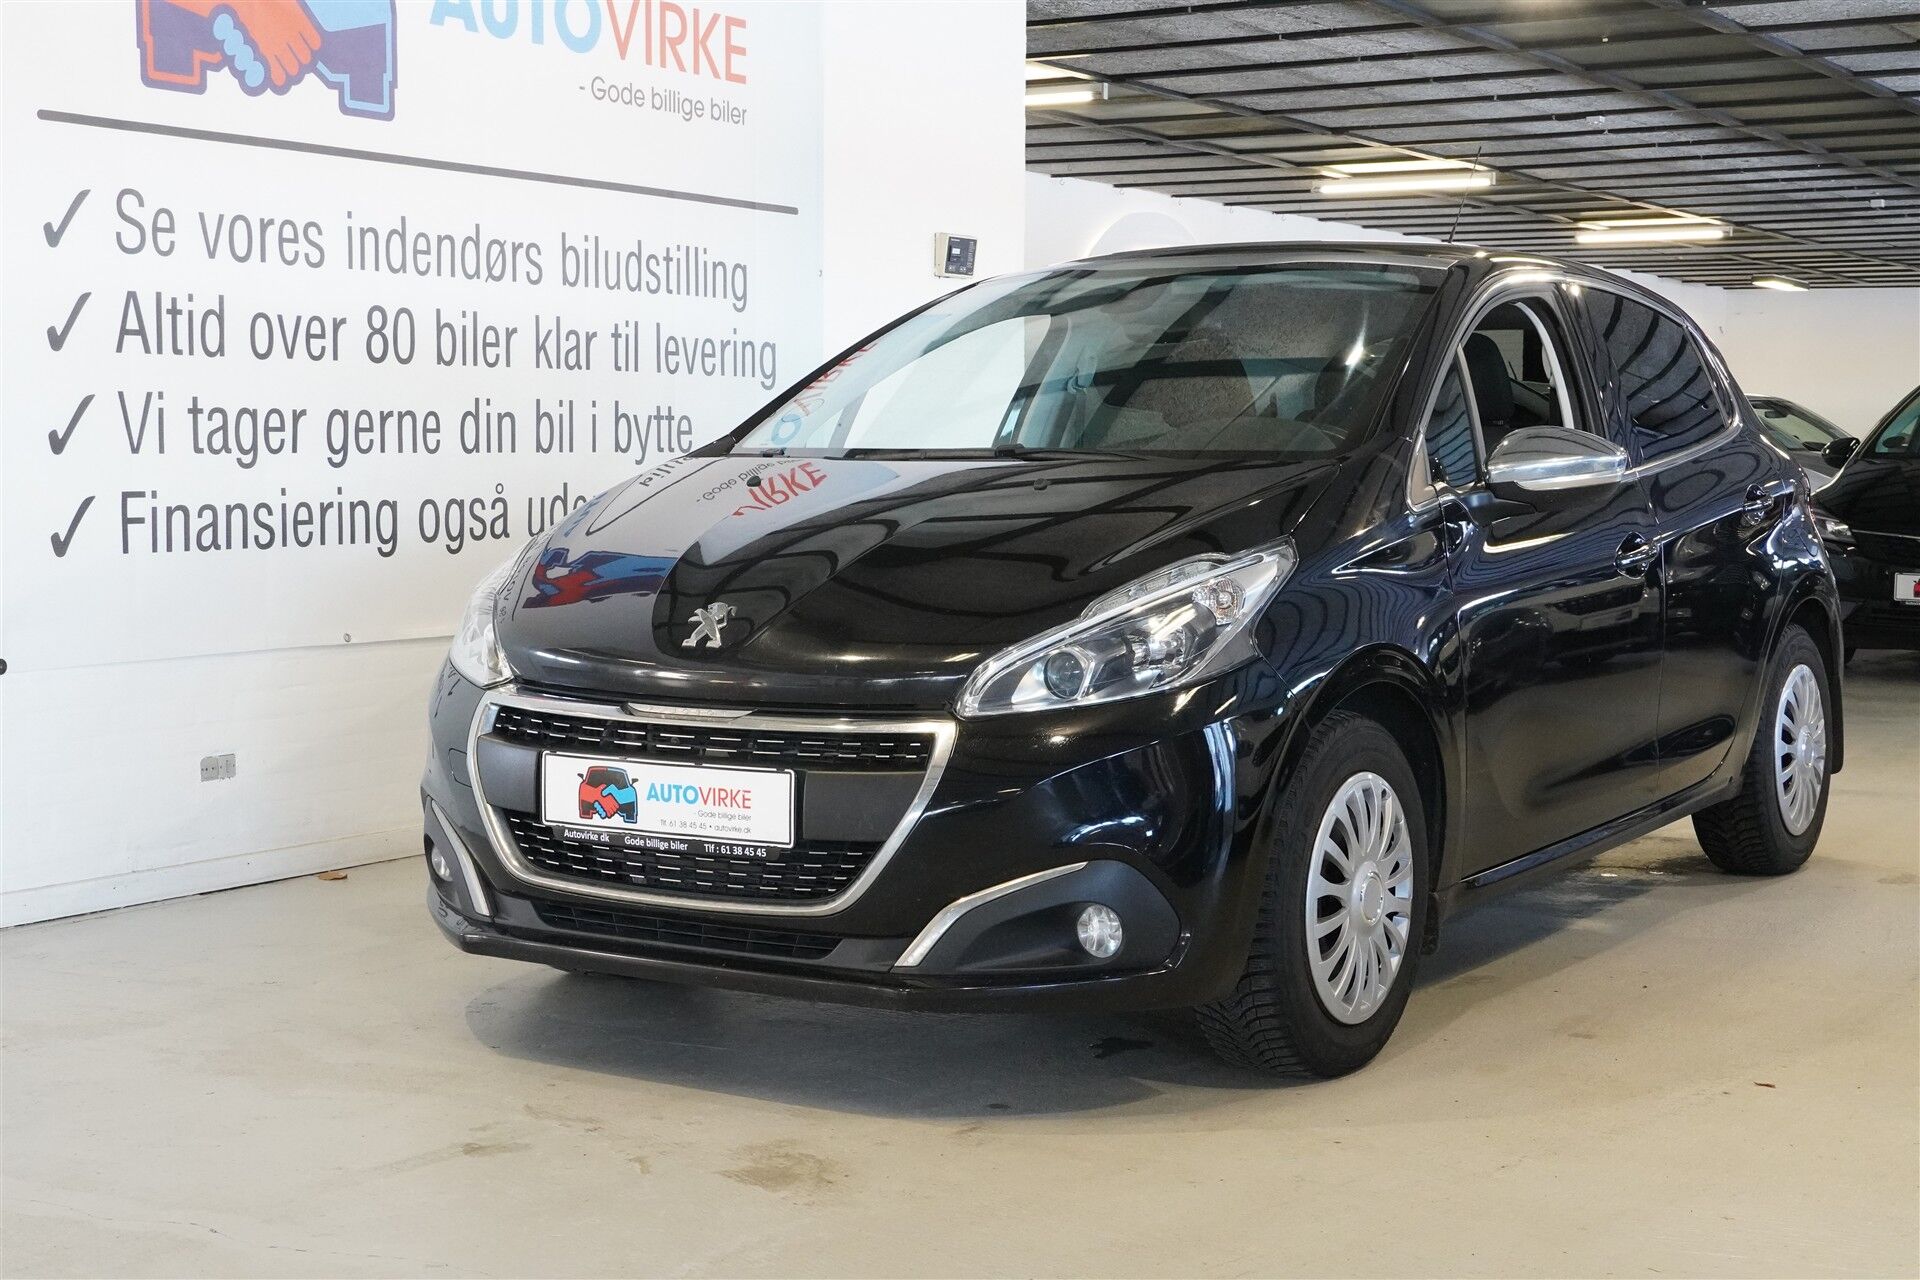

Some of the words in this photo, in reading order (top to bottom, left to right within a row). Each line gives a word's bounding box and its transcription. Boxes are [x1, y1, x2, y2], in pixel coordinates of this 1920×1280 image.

[591, 76, 645, 107] Gode
[651, 87, 704, 122] billige
[710, 98, 747, 126] biler
[115, 187, 176, 257] Se
[198, 211, 326, 269] vores
[346, 210, 544, 286] indendørs
[561, 231, 748, 313] biludstilling
[115, 290, 226, 359] Altid
[249, 311, 348, 362] over
[365, 304, 416, 366] 80
[435, 307, 518, 368] biler
[534, 314, 598, 371] klar
[610, 320, 639, 373] til
[655, 322, 777, 391] levering
[117, 390, 166, 455] Vi
[186, 396, 308, 470] tager
[325, 408, 442, 469] gerne
[459, 396, 517, 455] din
[535, 398, 574, 455] bil
[591, 399, 597, 454] i
[614, 399, 693, 466] bytte
[120, 486, 399, 558] Finansiering
[418, 482, 511, 556] også
[646, 782, 752, 810] AUTOVIRKE
[563, 828, 599, 841] Autovirke
[624, 836, 645, 847] Gode
[645, 837, 669, 851] billige
[669, 840, 689, 851] biler
[720, 845, 730, 855] 61
[732, 846, 744, 856] 38
[744, 847, 755, 857] 45
[756, 848, 767, 858] 45
